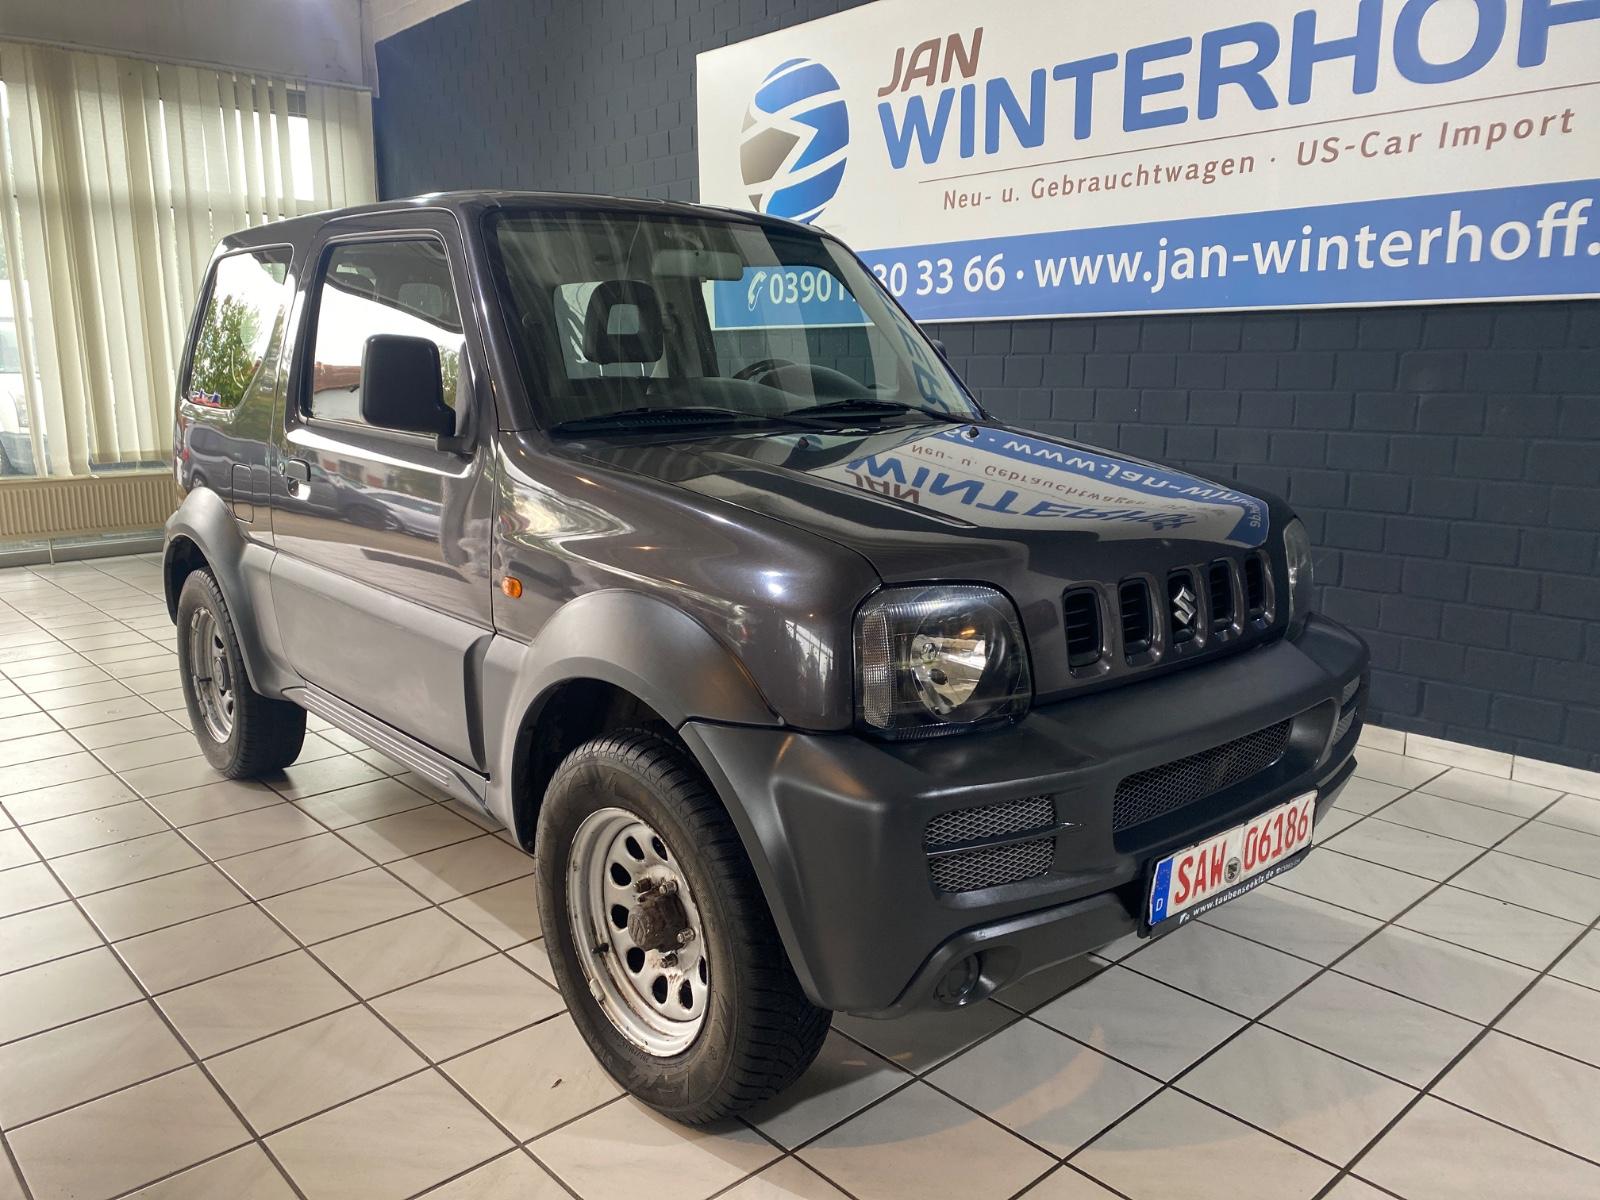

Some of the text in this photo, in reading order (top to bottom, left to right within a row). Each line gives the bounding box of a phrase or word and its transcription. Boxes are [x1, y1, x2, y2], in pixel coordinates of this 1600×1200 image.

[877, 26, 984, 98] JAN
[943, 108, 1576, 210] Neu- u. Gebrauchtwagen US-Car Import
[916, 257, 954, 297] 33
[963, 252, 1007, 293] 66
[1174, 800, 1310, 906] SAW 06186
[1155, 897, 1163, 912] D
